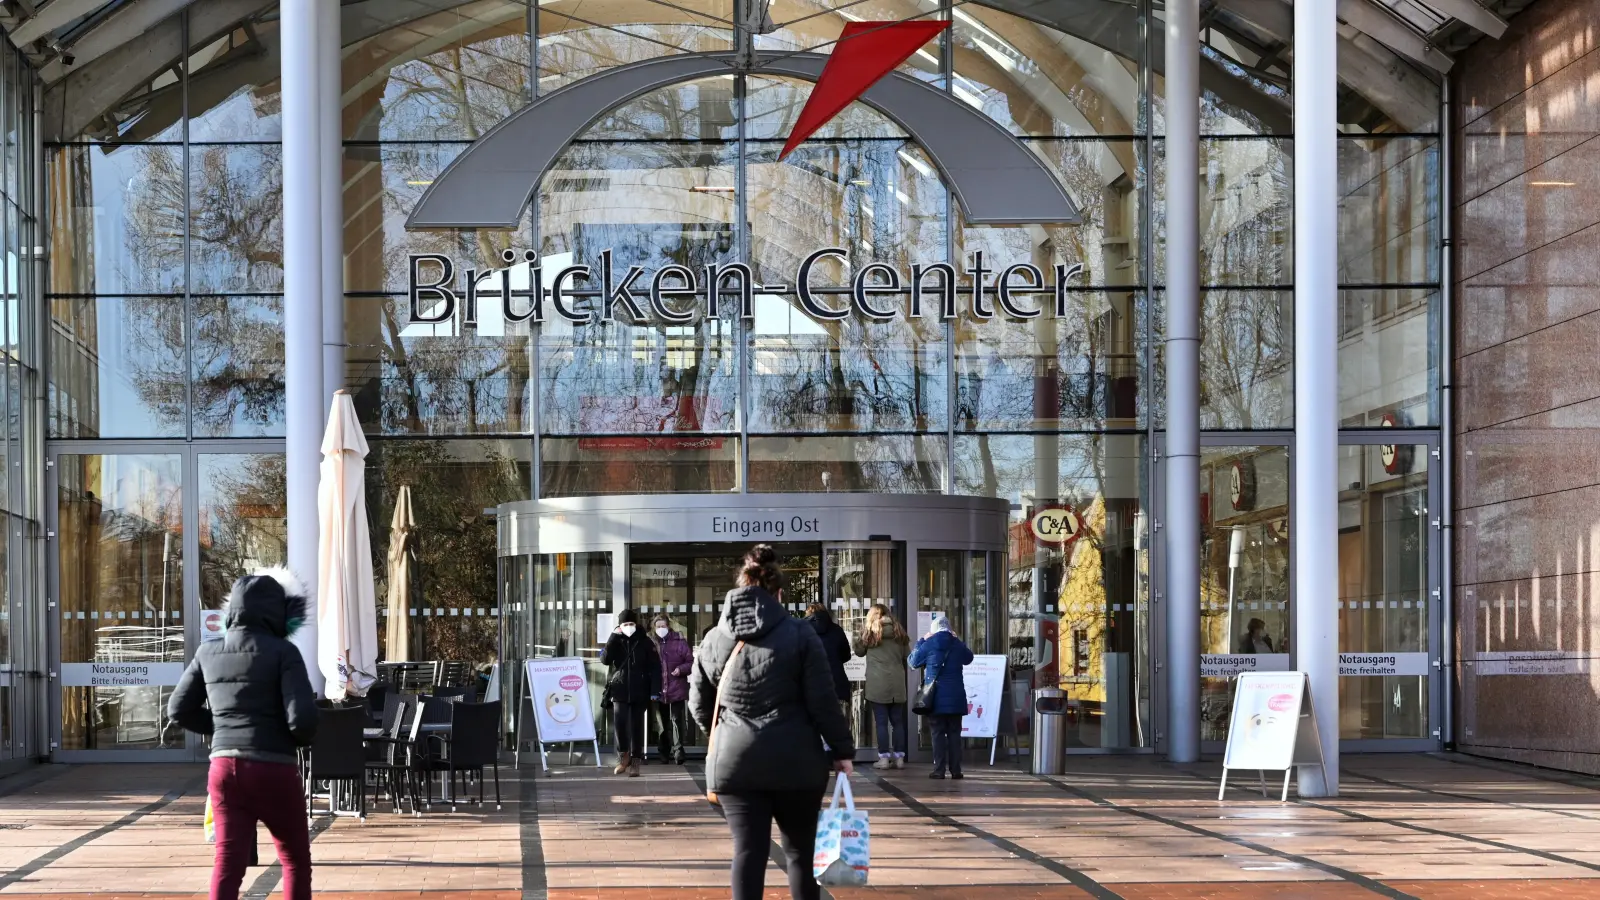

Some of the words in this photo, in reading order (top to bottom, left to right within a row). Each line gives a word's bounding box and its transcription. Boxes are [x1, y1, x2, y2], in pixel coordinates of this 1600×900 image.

[408, 248, 1084, 323] Brücken-Center
[712, 516, 784, 537] Eingang
[790, 516, 820, 533] Ost
[1036, 515, 1074, 535] C&A
[653, 568, 680, 578] Aufzug
[1200, 656, 1256, 667] Notausgang
[1339, 654, 1396, 666] Notausgang
[92, 664, 148, 676] Notausgang
[1200, 668, 1218, 676] Bitte
[1339, 667, 1357, 675] Bitte
[1359, 667, 1396, 675] freihalten
[91, 677, 110, 685] Bitte
[112, 677, 149, 685] freihalten
